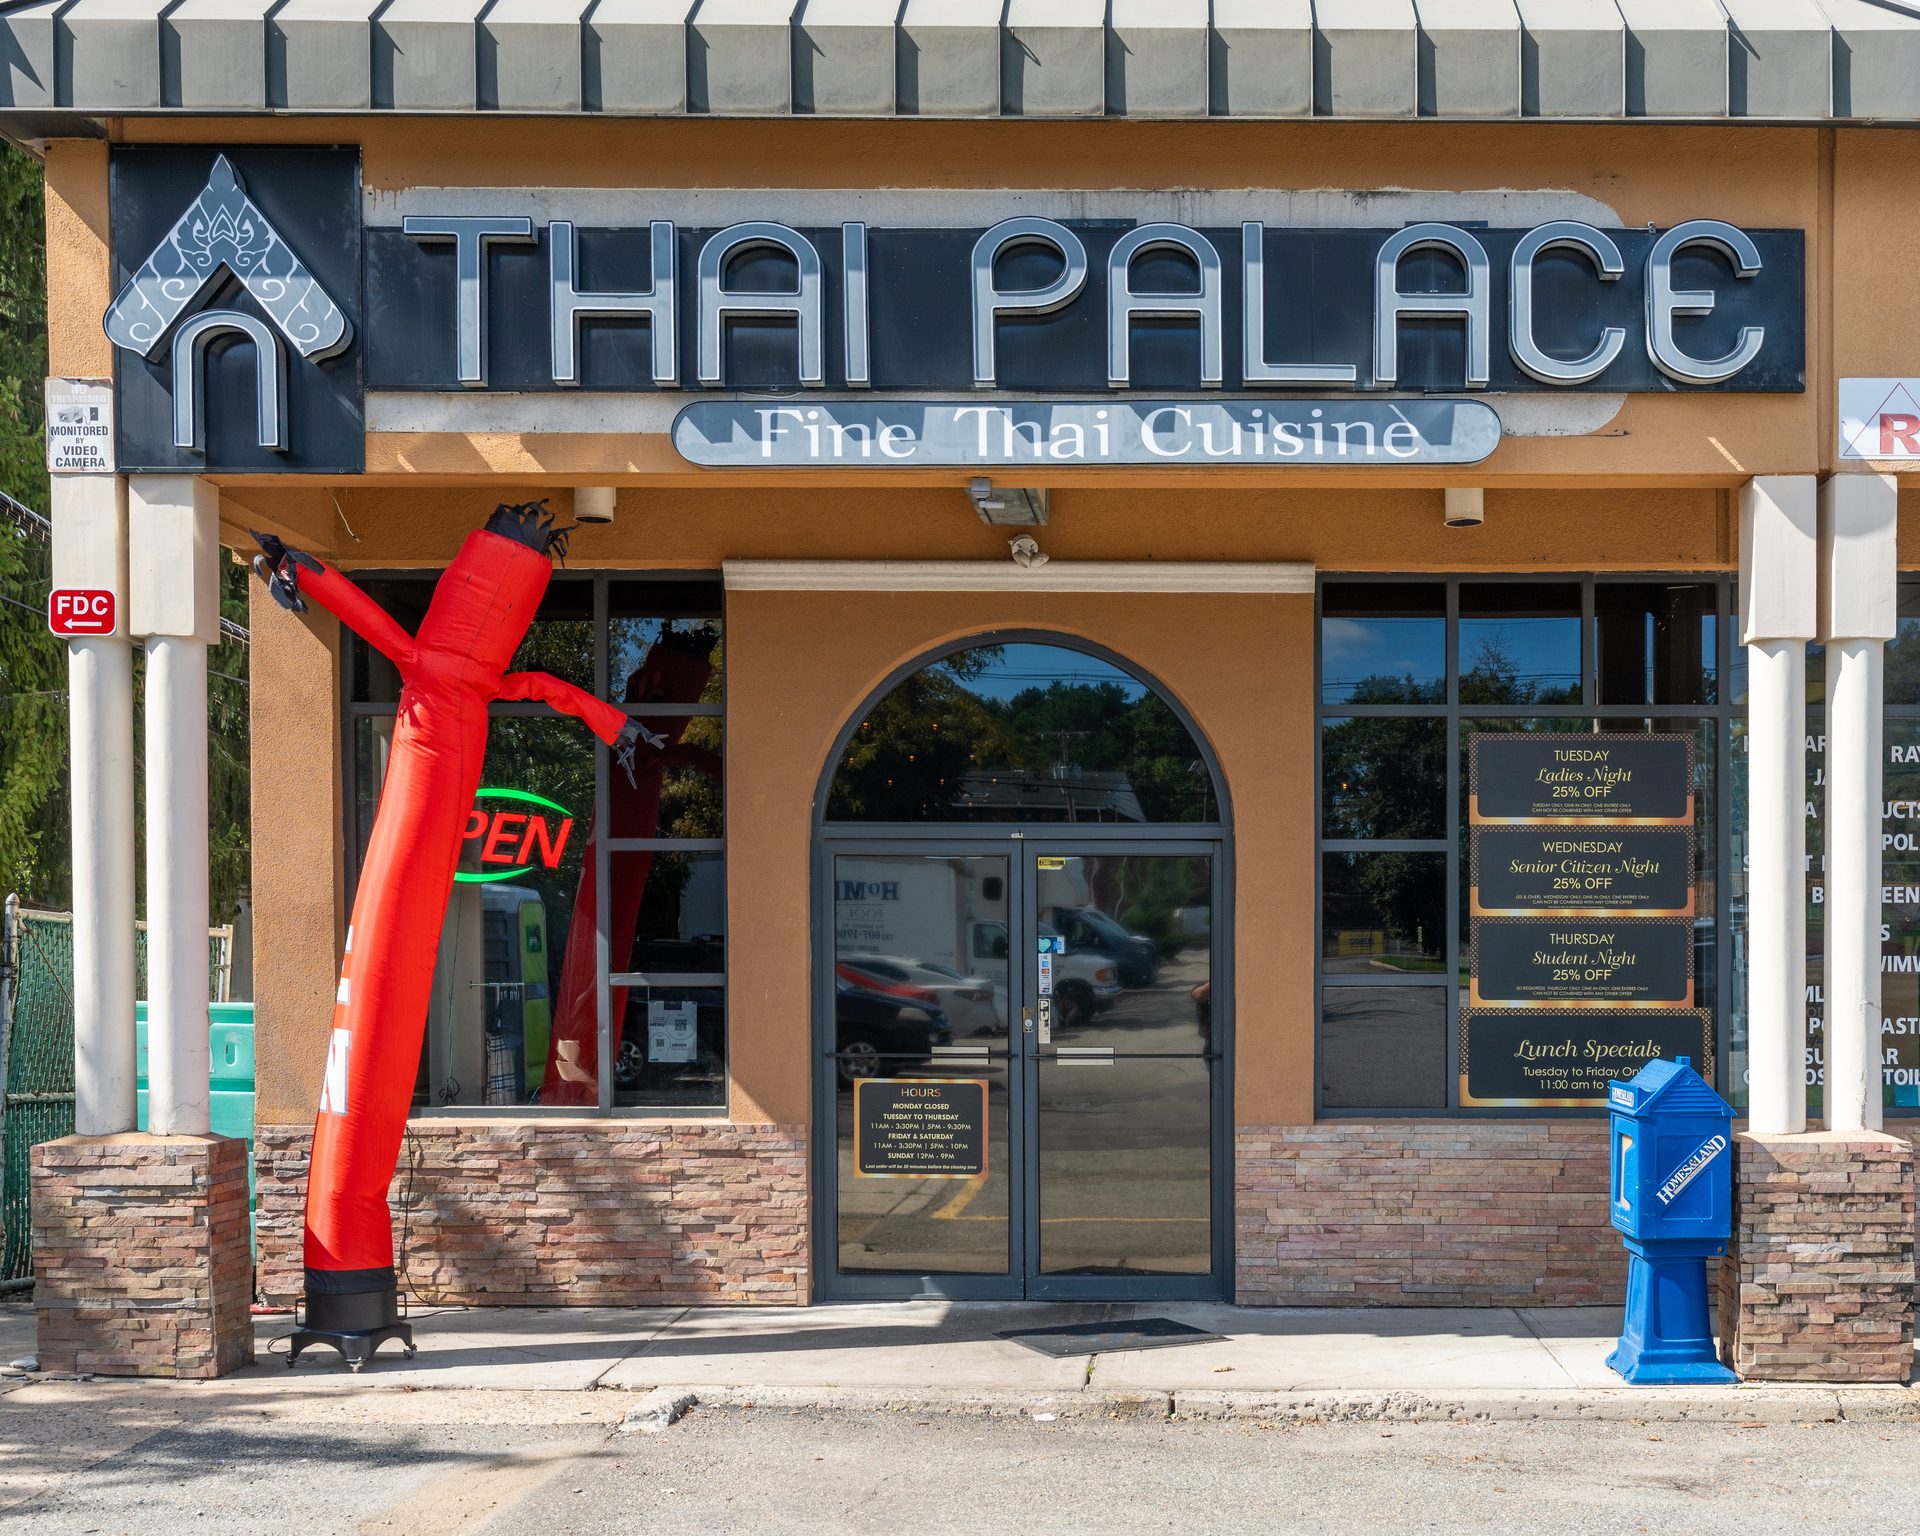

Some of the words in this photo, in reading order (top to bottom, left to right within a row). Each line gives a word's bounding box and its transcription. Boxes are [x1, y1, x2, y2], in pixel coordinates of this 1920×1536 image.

[402, 215, 871, 388] THAI
[970, 215, 1766, 388] PALACE
[71, 384, 87, 394] NO
[51, 394, 107, 404] TRESPASSING
[51, 426, 108, 436] MONITORED
[755, 408, 917, 459] Fine
[953, 407, 1111, 459] Thai
[62, 445, 98, 456] VIDEO
[55, 457, 106, 468] CAMERA
[57, 596, 108, 615] FDC
[1554, 750, 1609, 761] TUESDAY
[1534, 767, 1583, 784] Ladies
[1587, 765, 1632, 786] Night
[1552, 786, 1580, 797] 25%
[1584, 786, 1612, 797] OFF
[463, 810, 573, 869] PEN
[1542, 842, 1623, 853] WEDNESDAY
[1509, 859, 1557, 873] Senior
[1560, 859, 1611, 873] Citizen
[1614, 857, 1659, 878] Night
[1553, 878, 1581, 889] 25%
[1584, 878, 1612, 889] OFF
[1549, 933, 1615, 945] THURSDAY
[1532, 950, 1588, 965] Student
[1591, 949, 1636, 970] Night
[1553, 969, 1580, 981] 25%
[1584, 969, 1612, 981] OFF
[1513, 1039, 1578, 1061] Lunch
[1583, 1039, 1661, 1062] Specials
[1523, 1066, 1570, 1079] Tuesday
[1572, 1067, 1583, 1076] to
[1586, 1066, 1620, 1079] Friday
[1622, 1066, 1641, 1076] On
[1540, 1080, 1567, 1090] 11:00
[1570, 1082, 1589, 1090] am
[1593, 1080, 1604, 1090] to
[901, 1088, 941, 1097] HOURS
